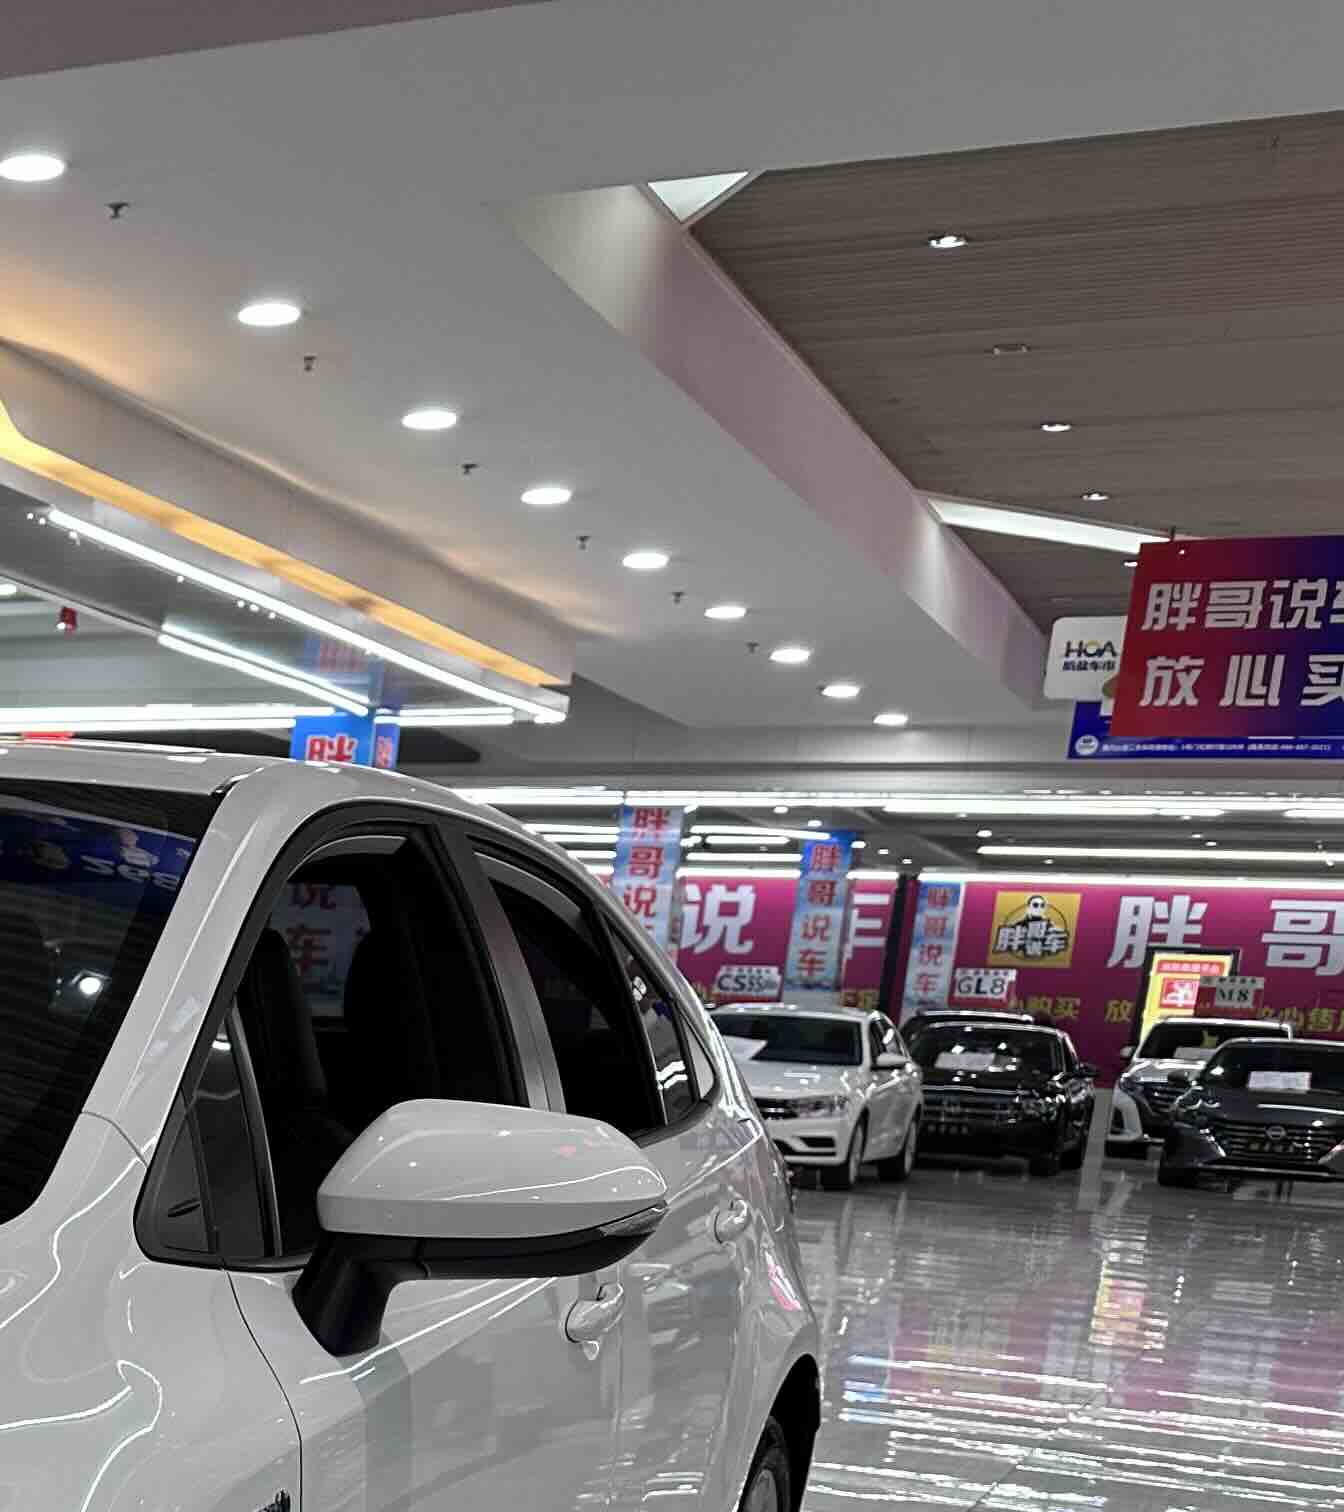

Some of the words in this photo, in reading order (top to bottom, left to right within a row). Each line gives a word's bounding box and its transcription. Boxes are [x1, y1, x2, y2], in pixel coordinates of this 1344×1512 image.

[1141, 579, 1344, 631] 胖哥说
[624, 808, 671, 930] 胖哥说
[958, 976, 1006, 995] GL8
